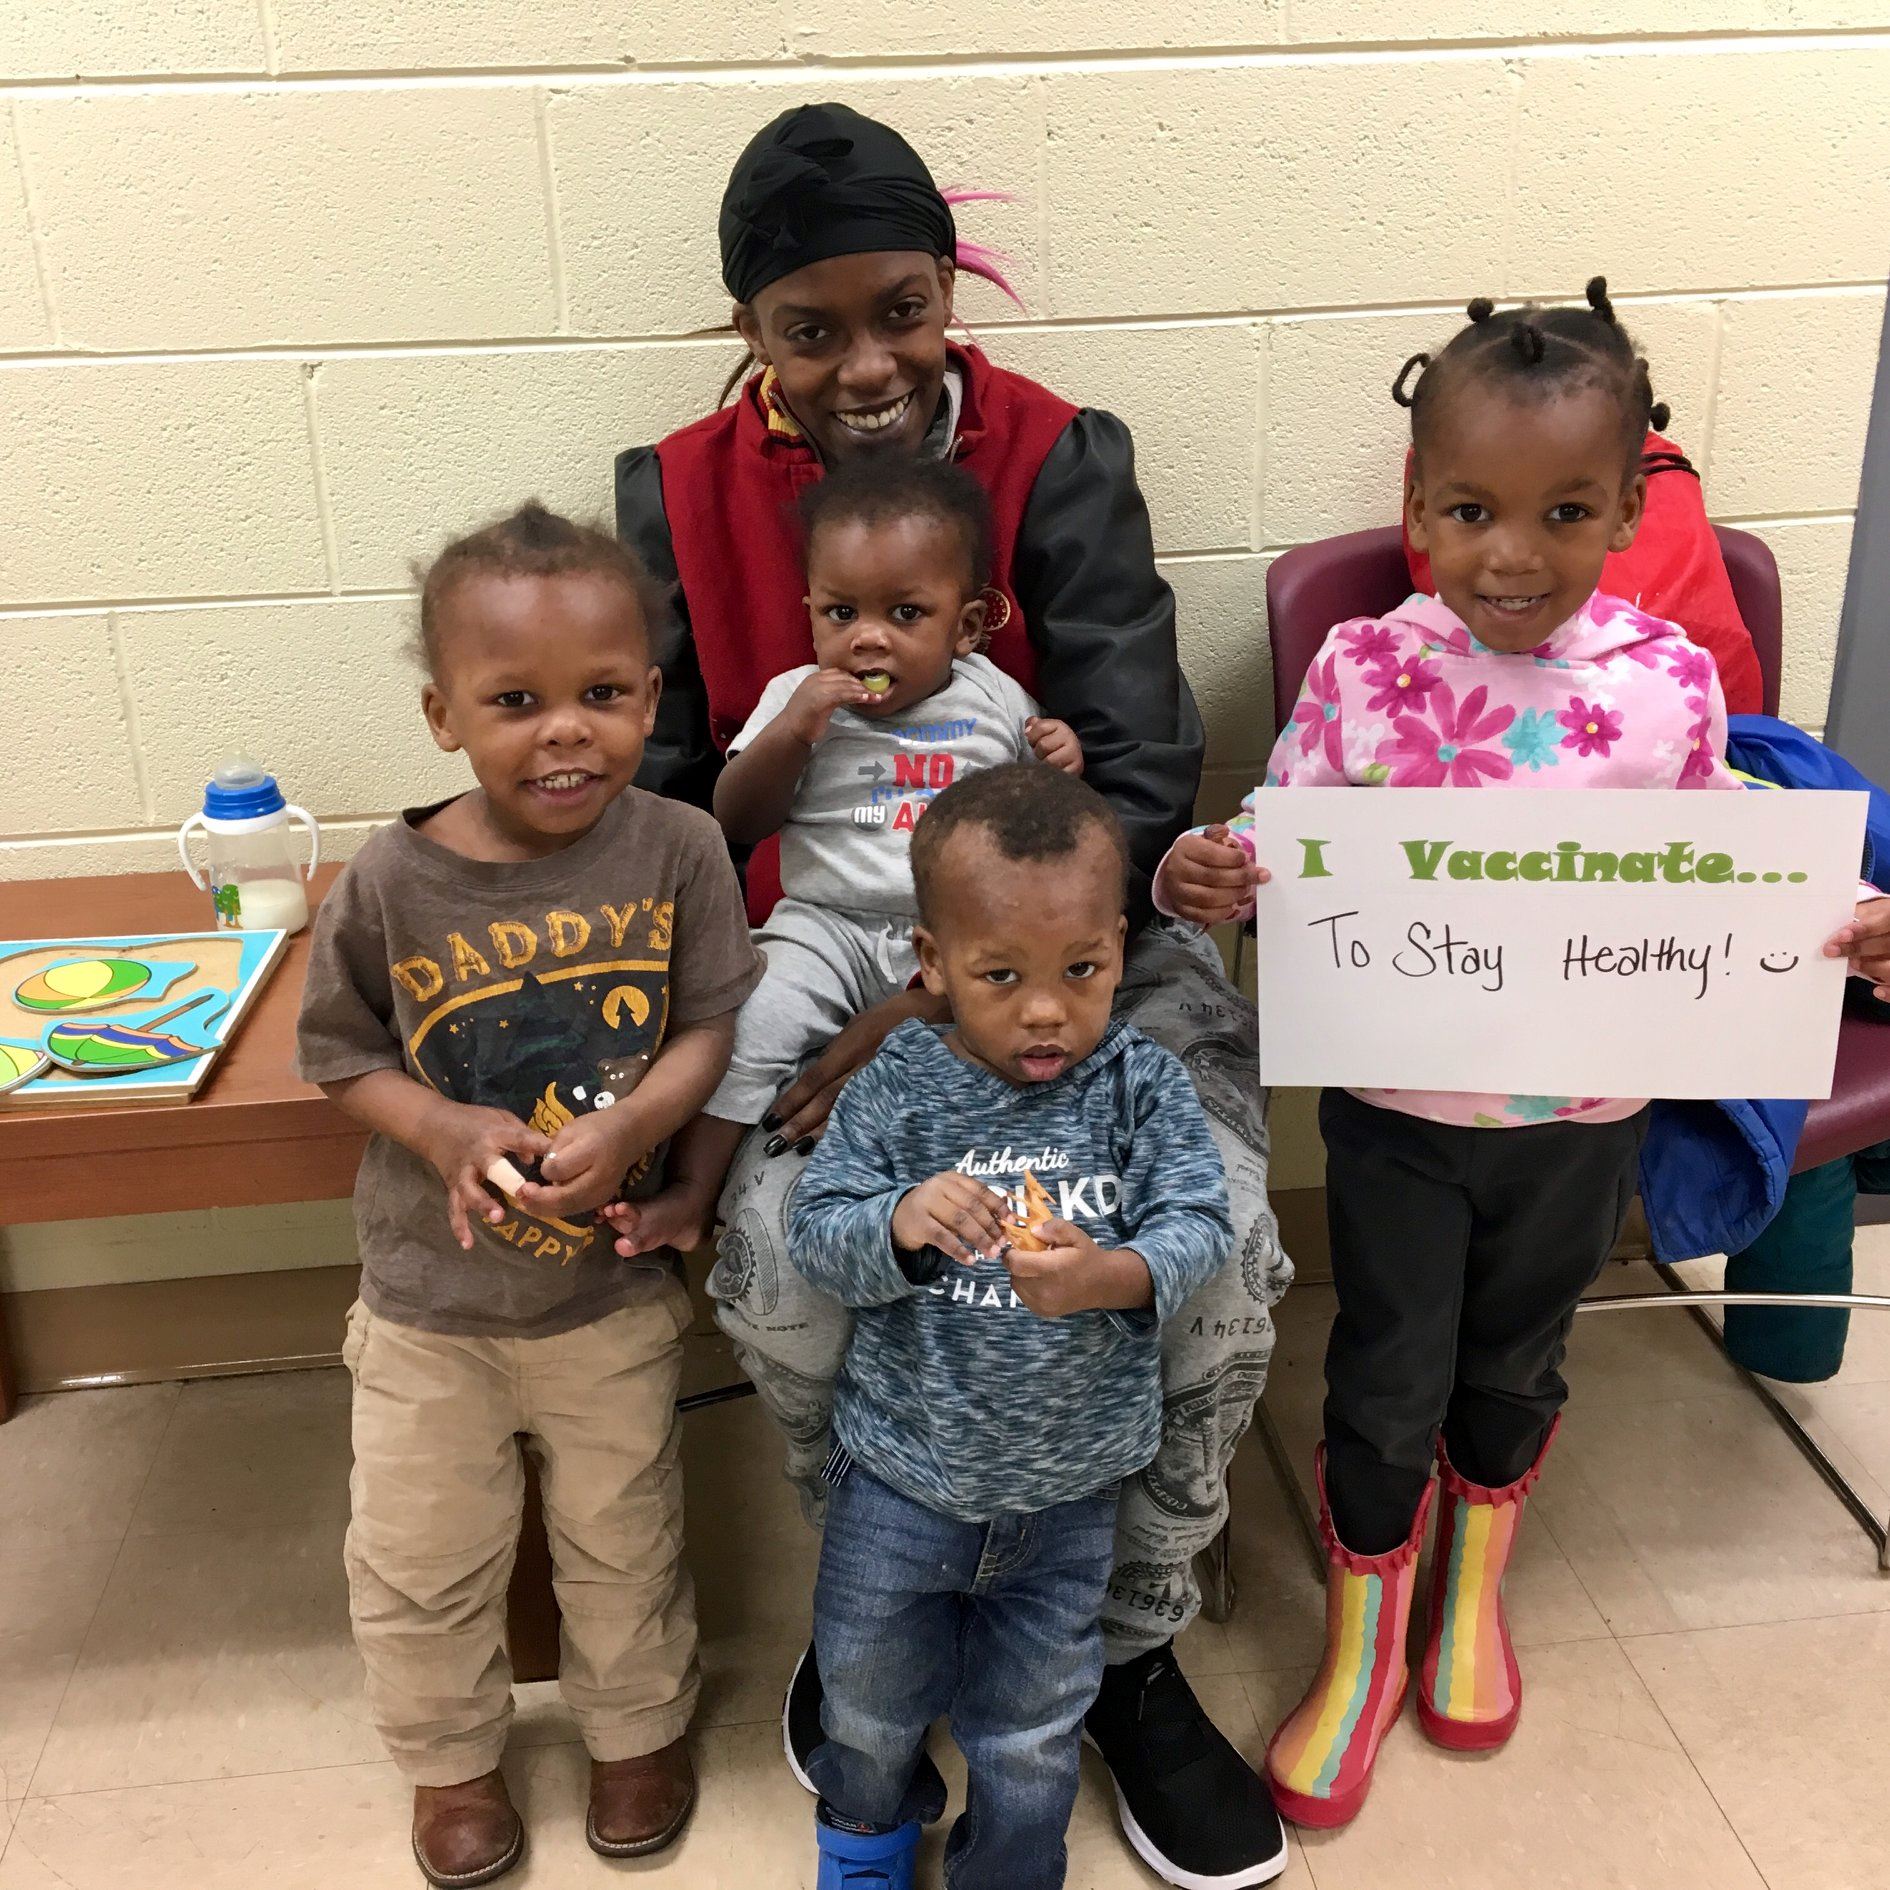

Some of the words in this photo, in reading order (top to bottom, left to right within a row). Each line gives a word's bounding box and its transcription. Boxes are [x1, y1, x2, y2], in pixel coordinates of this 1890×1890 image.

[893, 753, 955, 789] NO
[854, 805, 886, 824] my
[1297, 839, 1332, 879] I
[1400, 840, 1808, 884] Vaccinate...
[391, 897, 674, 1002] DADDY'S
[1308, 911, 1370, 969] To
[1392, 922, 1503, 992] Stay
[1563, 934, 1732, 1000] Healthy!
[955, 1146, 1070, 1176] Authentic
